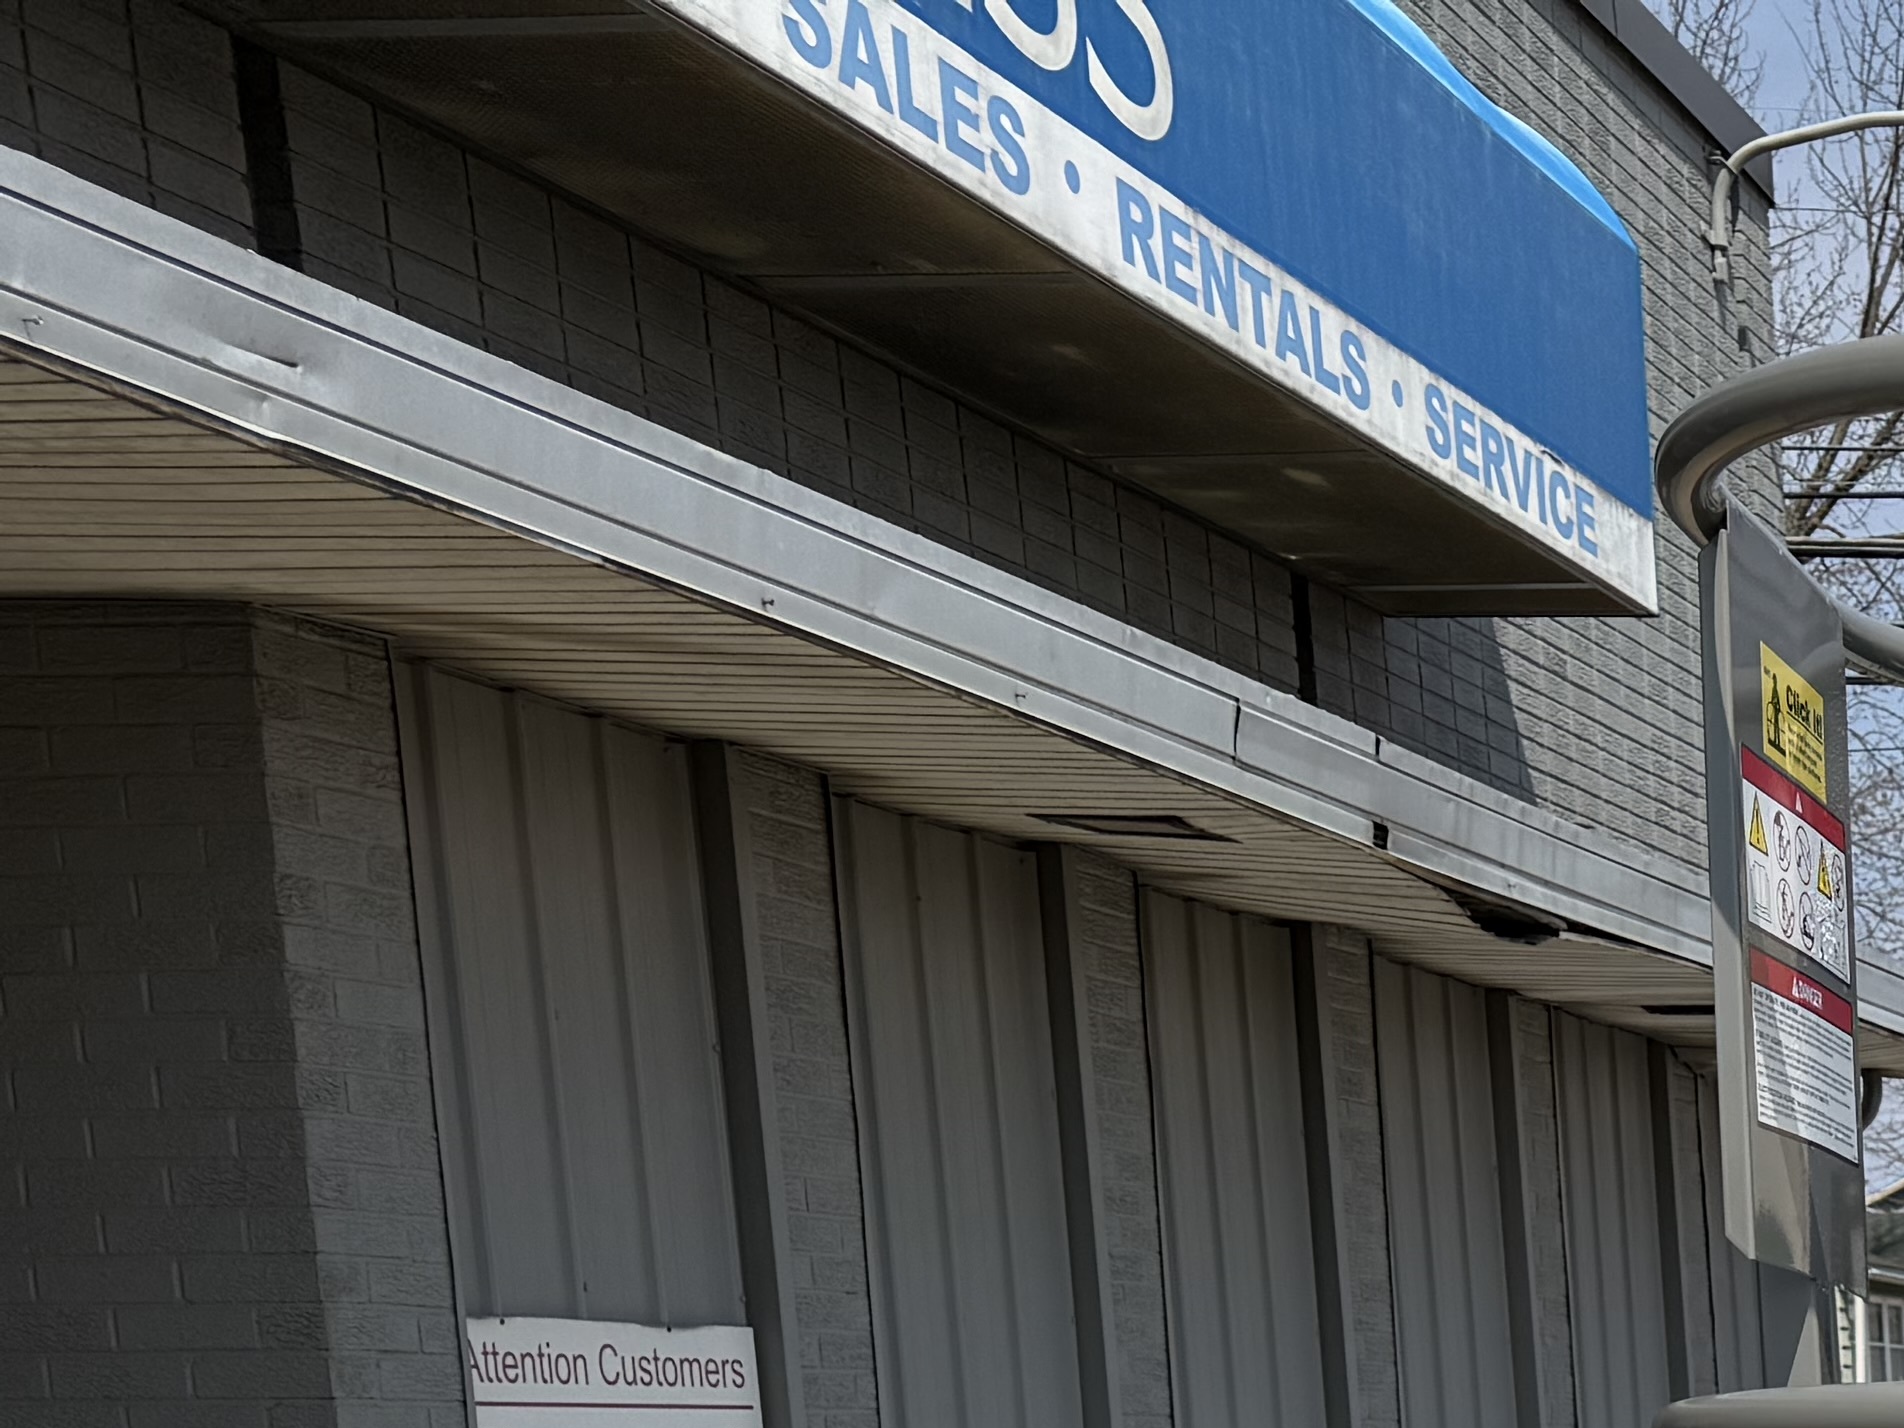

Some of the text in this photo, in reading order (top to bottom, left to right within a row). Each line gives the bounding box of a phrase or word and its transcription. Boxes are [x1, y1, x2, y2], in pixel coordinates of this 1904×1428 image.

[782, 0, 1030, 196] SALES
[1116, 176, 1370, 411] RENTALS
[1424, 383, 1599, 558] SERVICE
[599, 1343, 745, 1388] Customers
